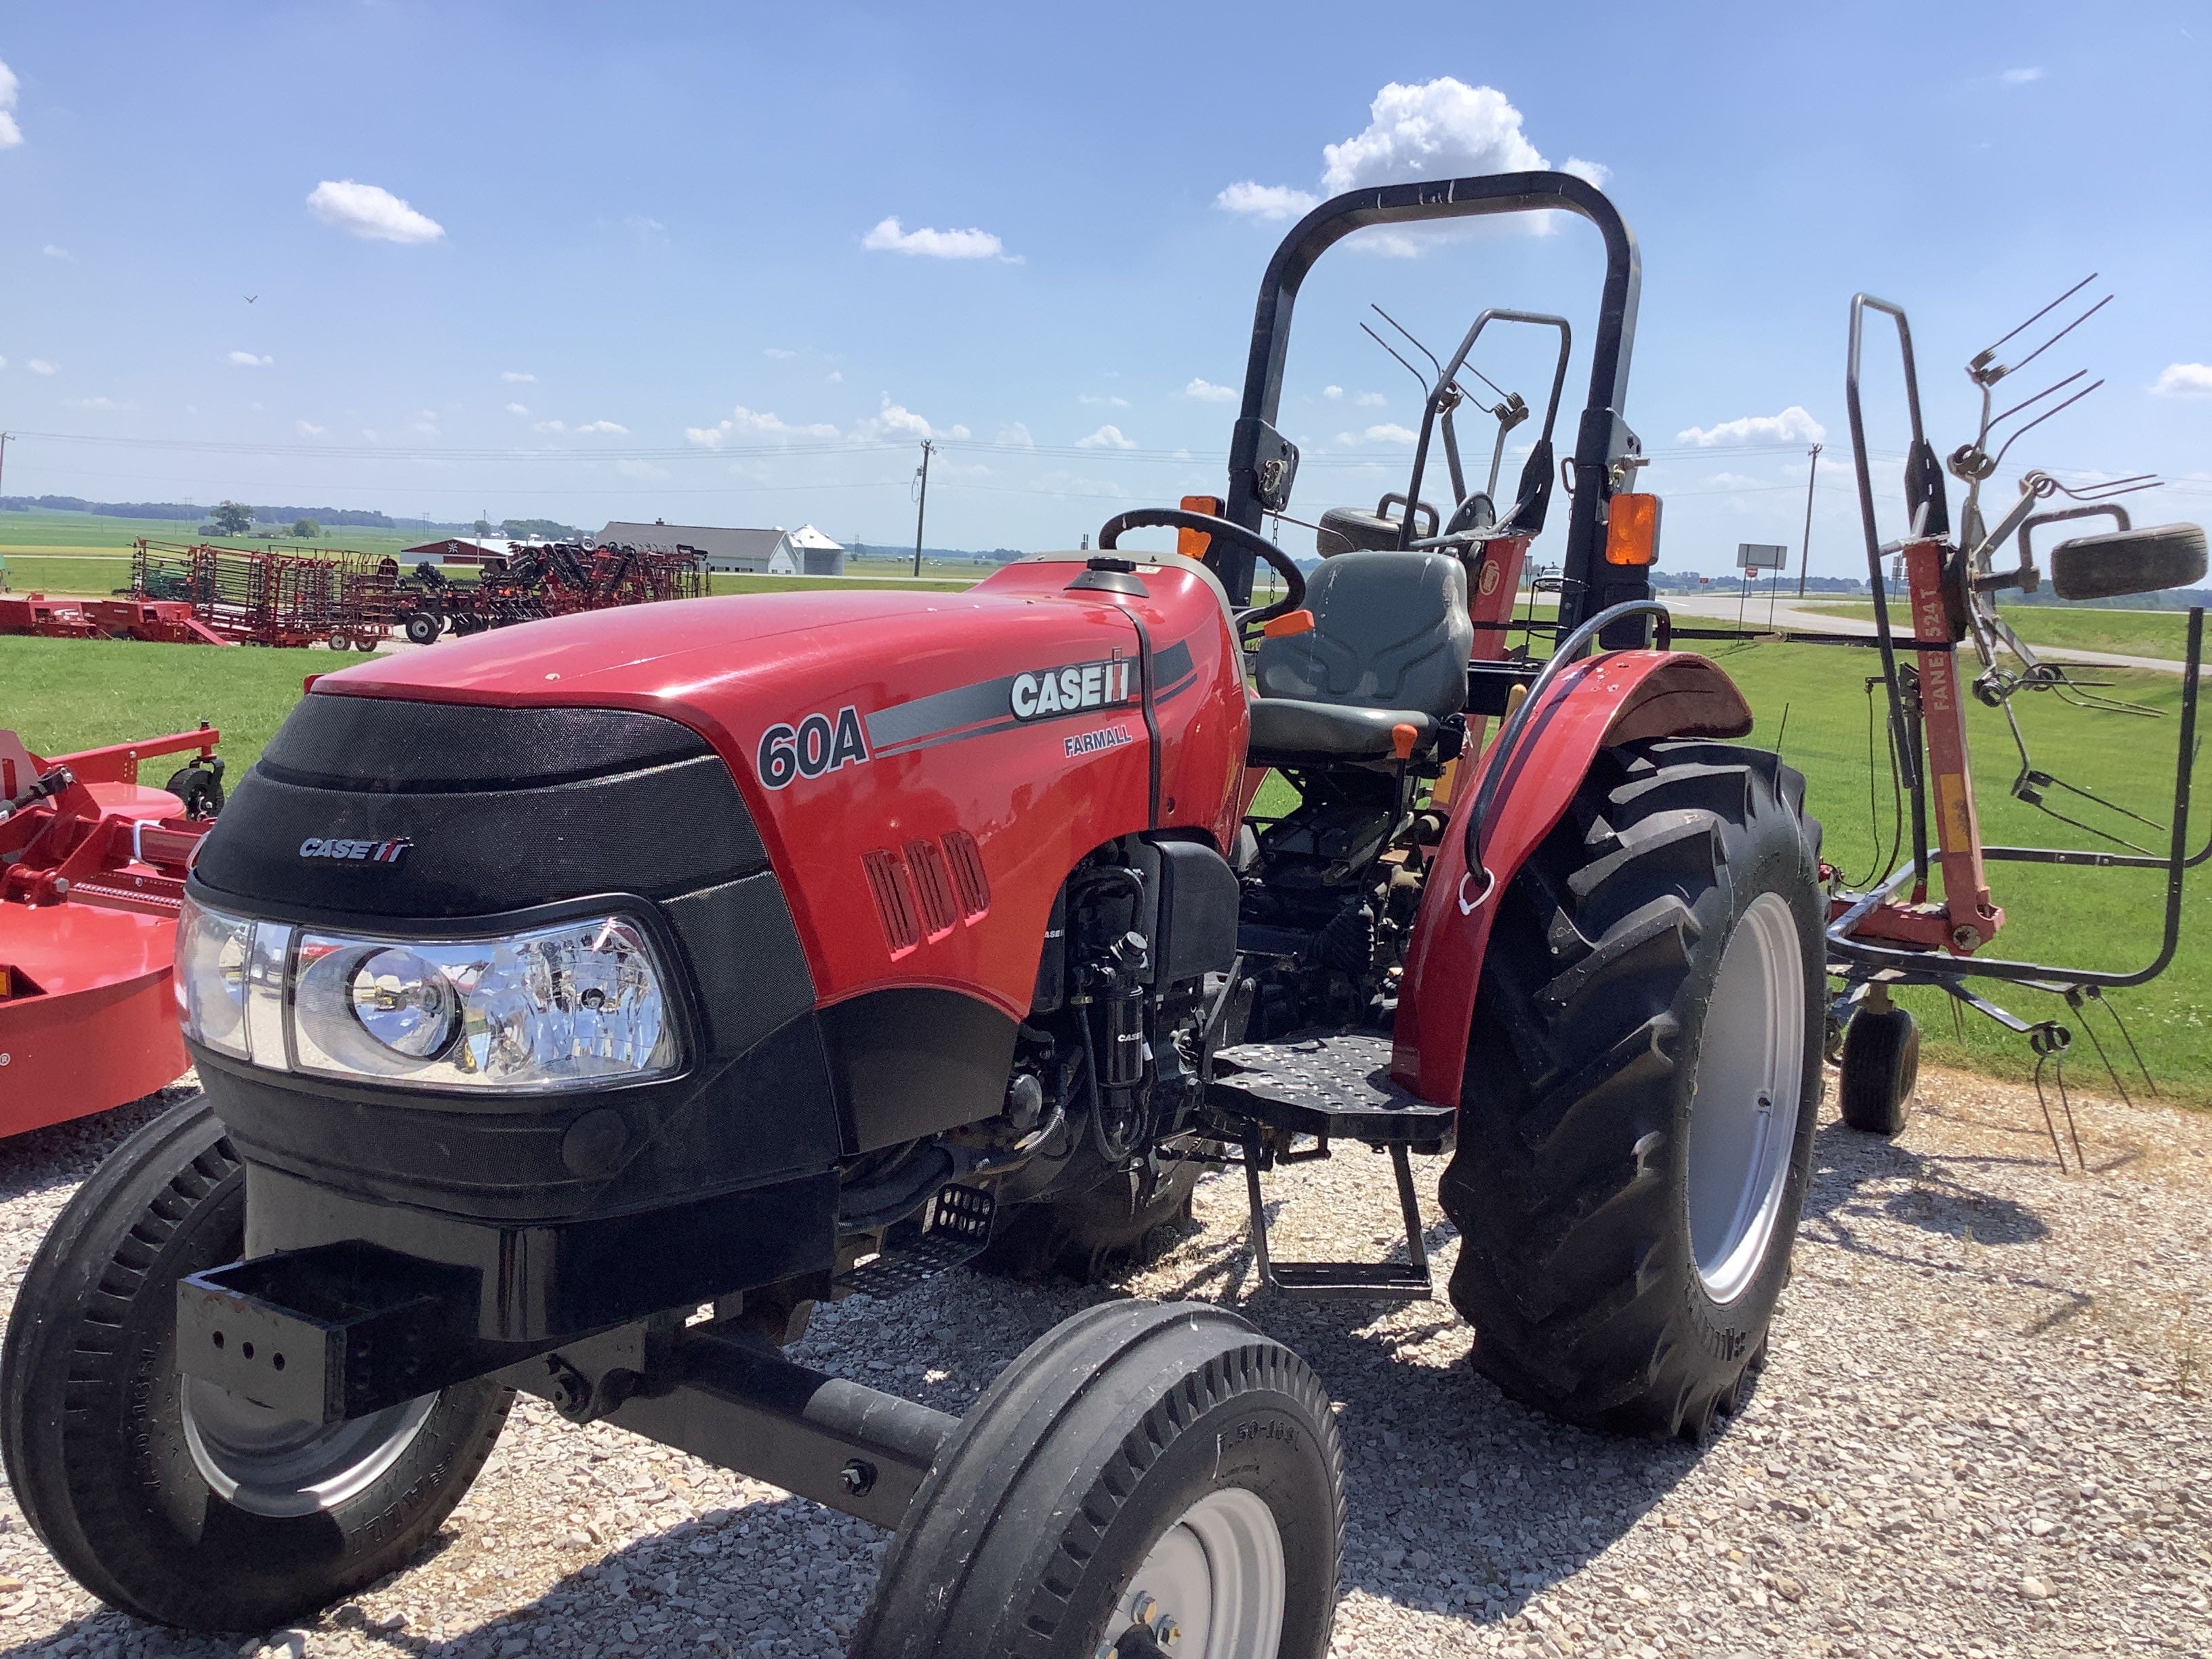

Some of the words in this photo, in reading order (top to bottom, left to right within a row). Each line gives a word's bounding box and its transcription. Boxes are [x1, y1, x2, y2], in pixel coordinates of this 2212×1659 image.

[1919, 588, 1938, 599] T
[1922, 601, 1944, 637] 524
[1011, 665, 1102, 718] CASE
[758, 706, 869, 790] 60A
[1064, 725, 1132, 758] FARMALL
[299, 838, 373, 859] CASE
